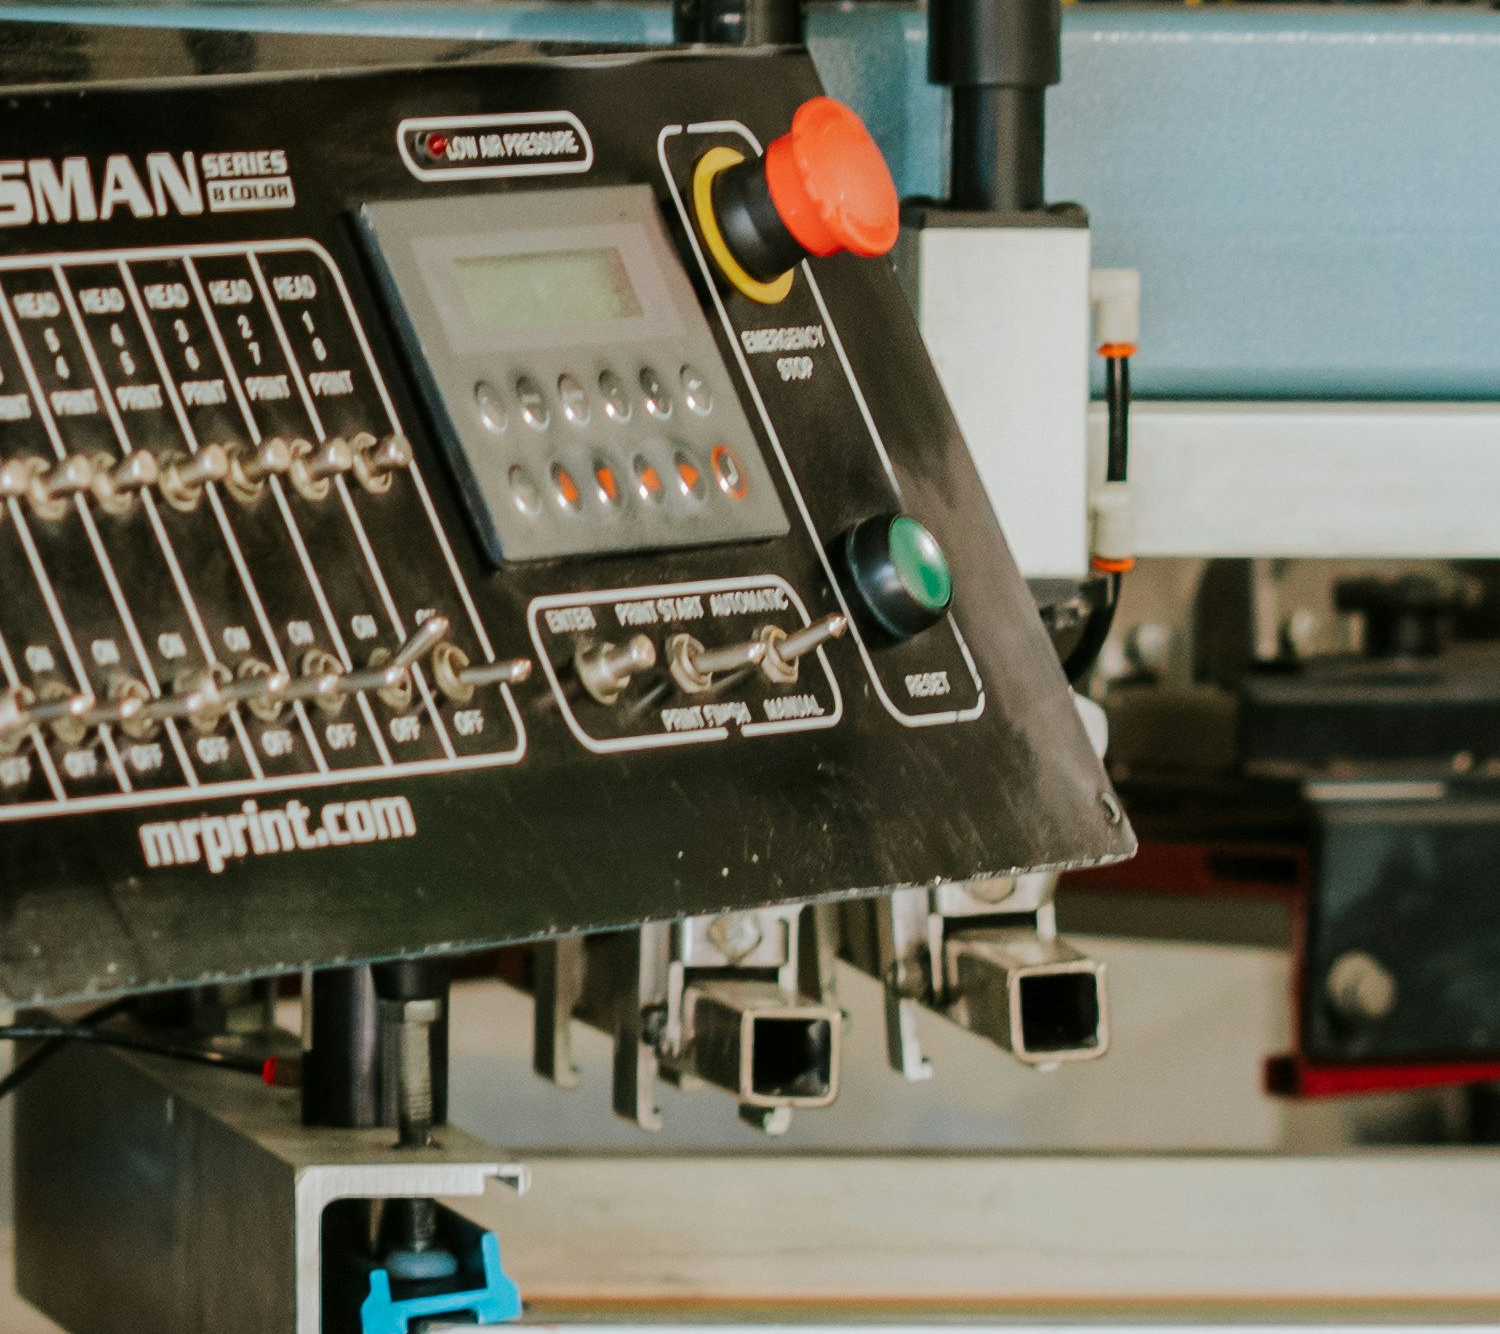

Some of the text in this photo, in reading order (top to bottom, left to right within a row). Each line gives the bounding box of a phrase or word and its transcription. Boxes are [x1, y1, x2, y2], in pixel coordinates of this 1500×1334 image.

[446, 129, 580, 161] LOW AIR PRESSURE
[202, 149, 289, 179] SERIES
[229, 183, 290, 201] COLOR
[79, 287, 126, 314] HEAD
[144, 283, 189, 309] HEAD
[208, 278, 253, 305] HEAD
[272, 274, 317, 301] HEAD
[12, 291, 61, 318] HEAD
[237, 314, 253, 339] 2
[302, 310, 315, 334] 1
[741, 324, 826, 355] EMERGENCY
[248, 341, 261, 366] 7
[776, 356, 814, 382] STOP
[116, 383, 163, 411] PRINT
[181, 379, 228, 406] PRINT
[245, 374, 291, 401] PRINT
[308, 370, 354, 397] PRINT
[50, 388, 99, 416] PRINT
[614, 595, 704, 627] PRINT START
[709, 587, 789, 617] AUTOMATIC
[287, 620, 315, 645] ON
[351, 614, 378, 640] ON
[544, 605, 598, 634] ENTER
[91, 639, 120, 665] ON
[157, 632, 187, 659] ON
[223, 626, 251, 652] ON
[25, 645, 54, 672] ON
[904, 671, 951, 698] RESET
[660, 701, 752, 733] PRINT FINISH
[763, 693, 825, 721] MANUAL
[325, 723, 357, 750] OFF
[389, 716, 421, 743] OFF
[453, 709, 484, 737] OFF
[197, 735, 230, 764] OFF
[261, 729, 294, 758] OFF
[130, 743, 163, 772] OFF
[138, 795, 418, 874] mrprint.com
